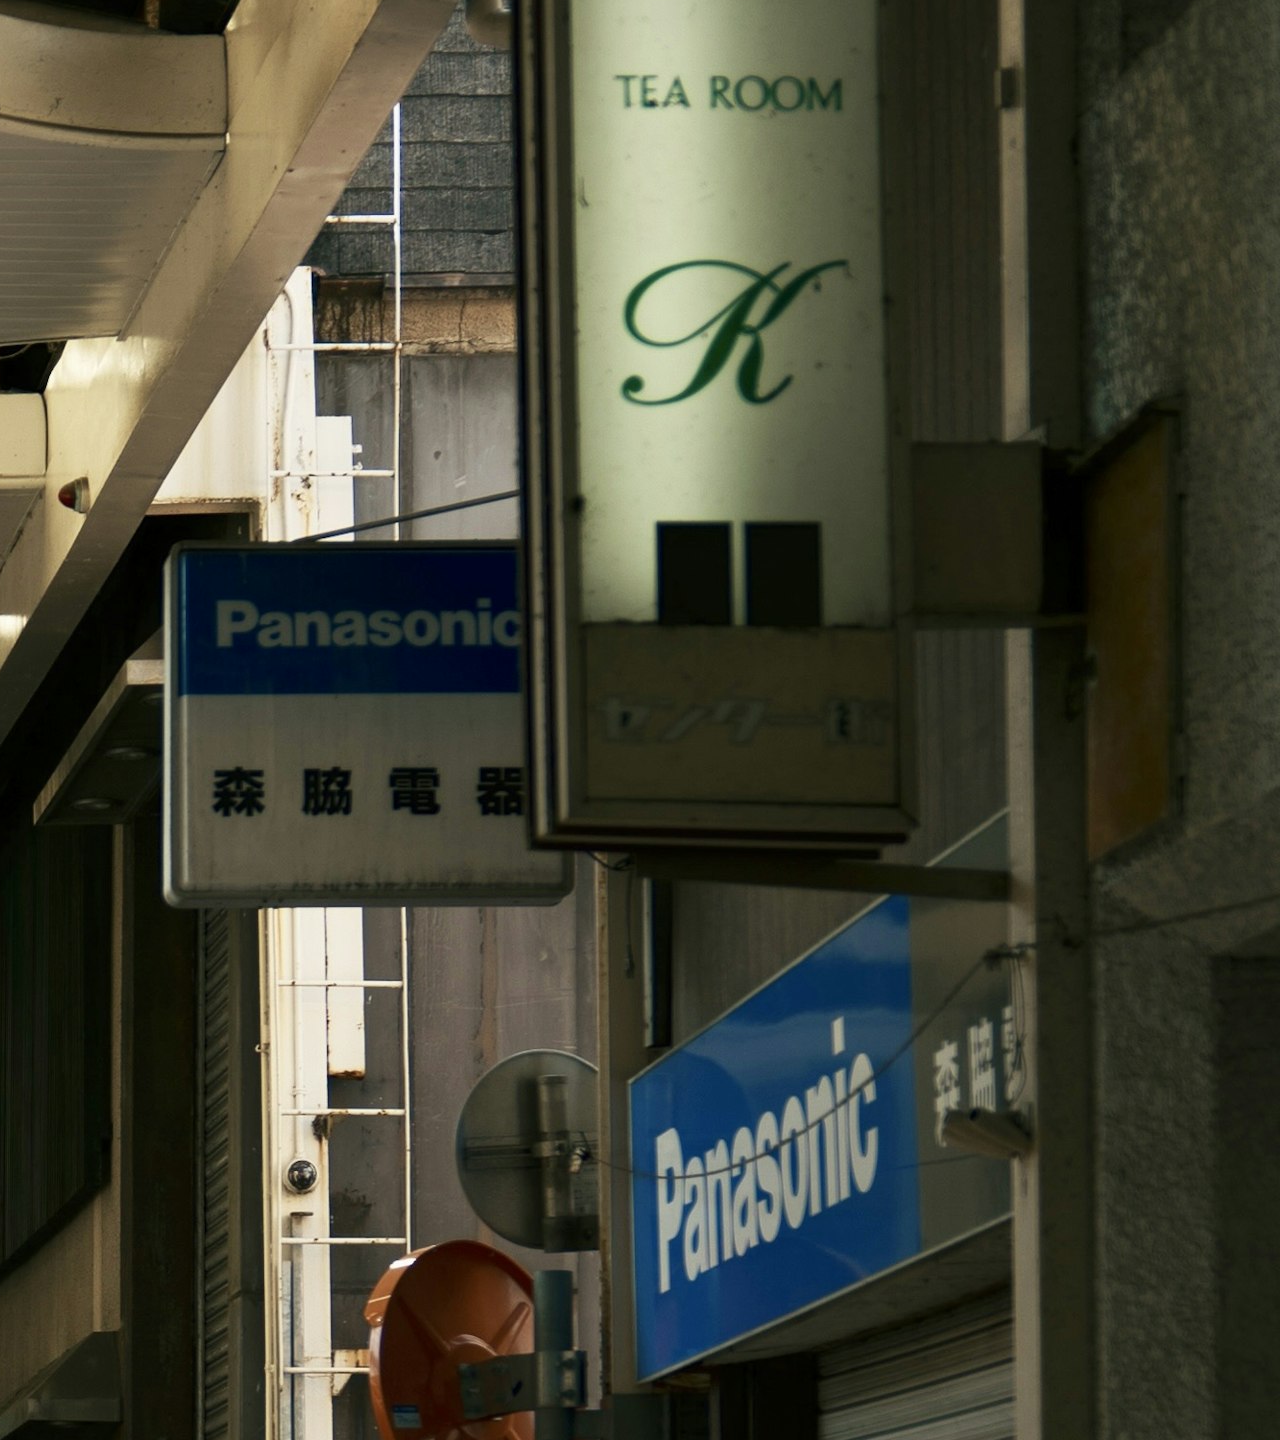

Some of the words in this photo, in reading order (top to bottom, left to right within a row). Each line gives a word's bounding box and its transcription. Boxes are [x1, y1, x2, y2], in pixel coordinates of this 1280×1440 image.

[613, 73, 690, 111] TEA
[709, 73, 844, 114] ROOM
[618, 257, 850, 408] K
[214, 597, 523, 649] Panasonic
[212, 765, 526, 818] 森脇電器
[653, 1016, 880, 1295] Panasonic
